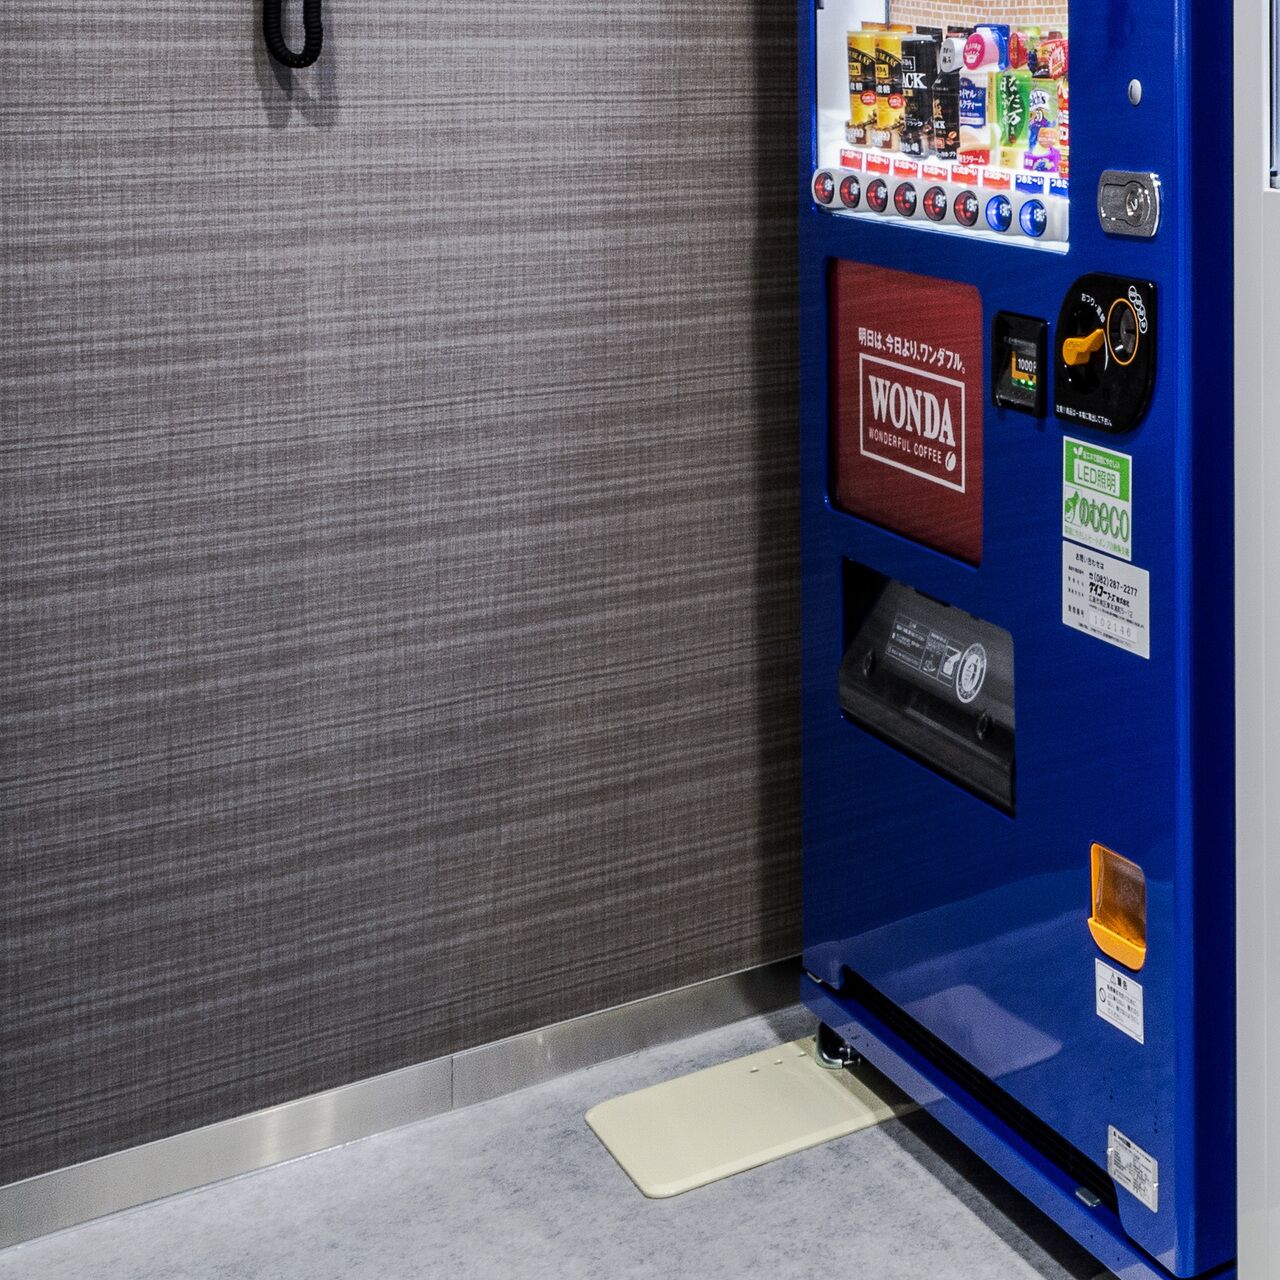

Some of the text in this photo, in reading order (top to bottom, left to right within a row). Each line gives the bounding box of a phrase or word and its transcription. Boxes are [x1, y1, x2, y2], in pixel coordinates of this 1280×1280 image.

[858, 327, 966, 375] 明日は、今日より、ワンダフル。
[868, 374, 956, 447] WONDA
[869, 427, 942, 465] WONDERFUL COFFEE
[1078, 464, 1116, 493] LED照明
